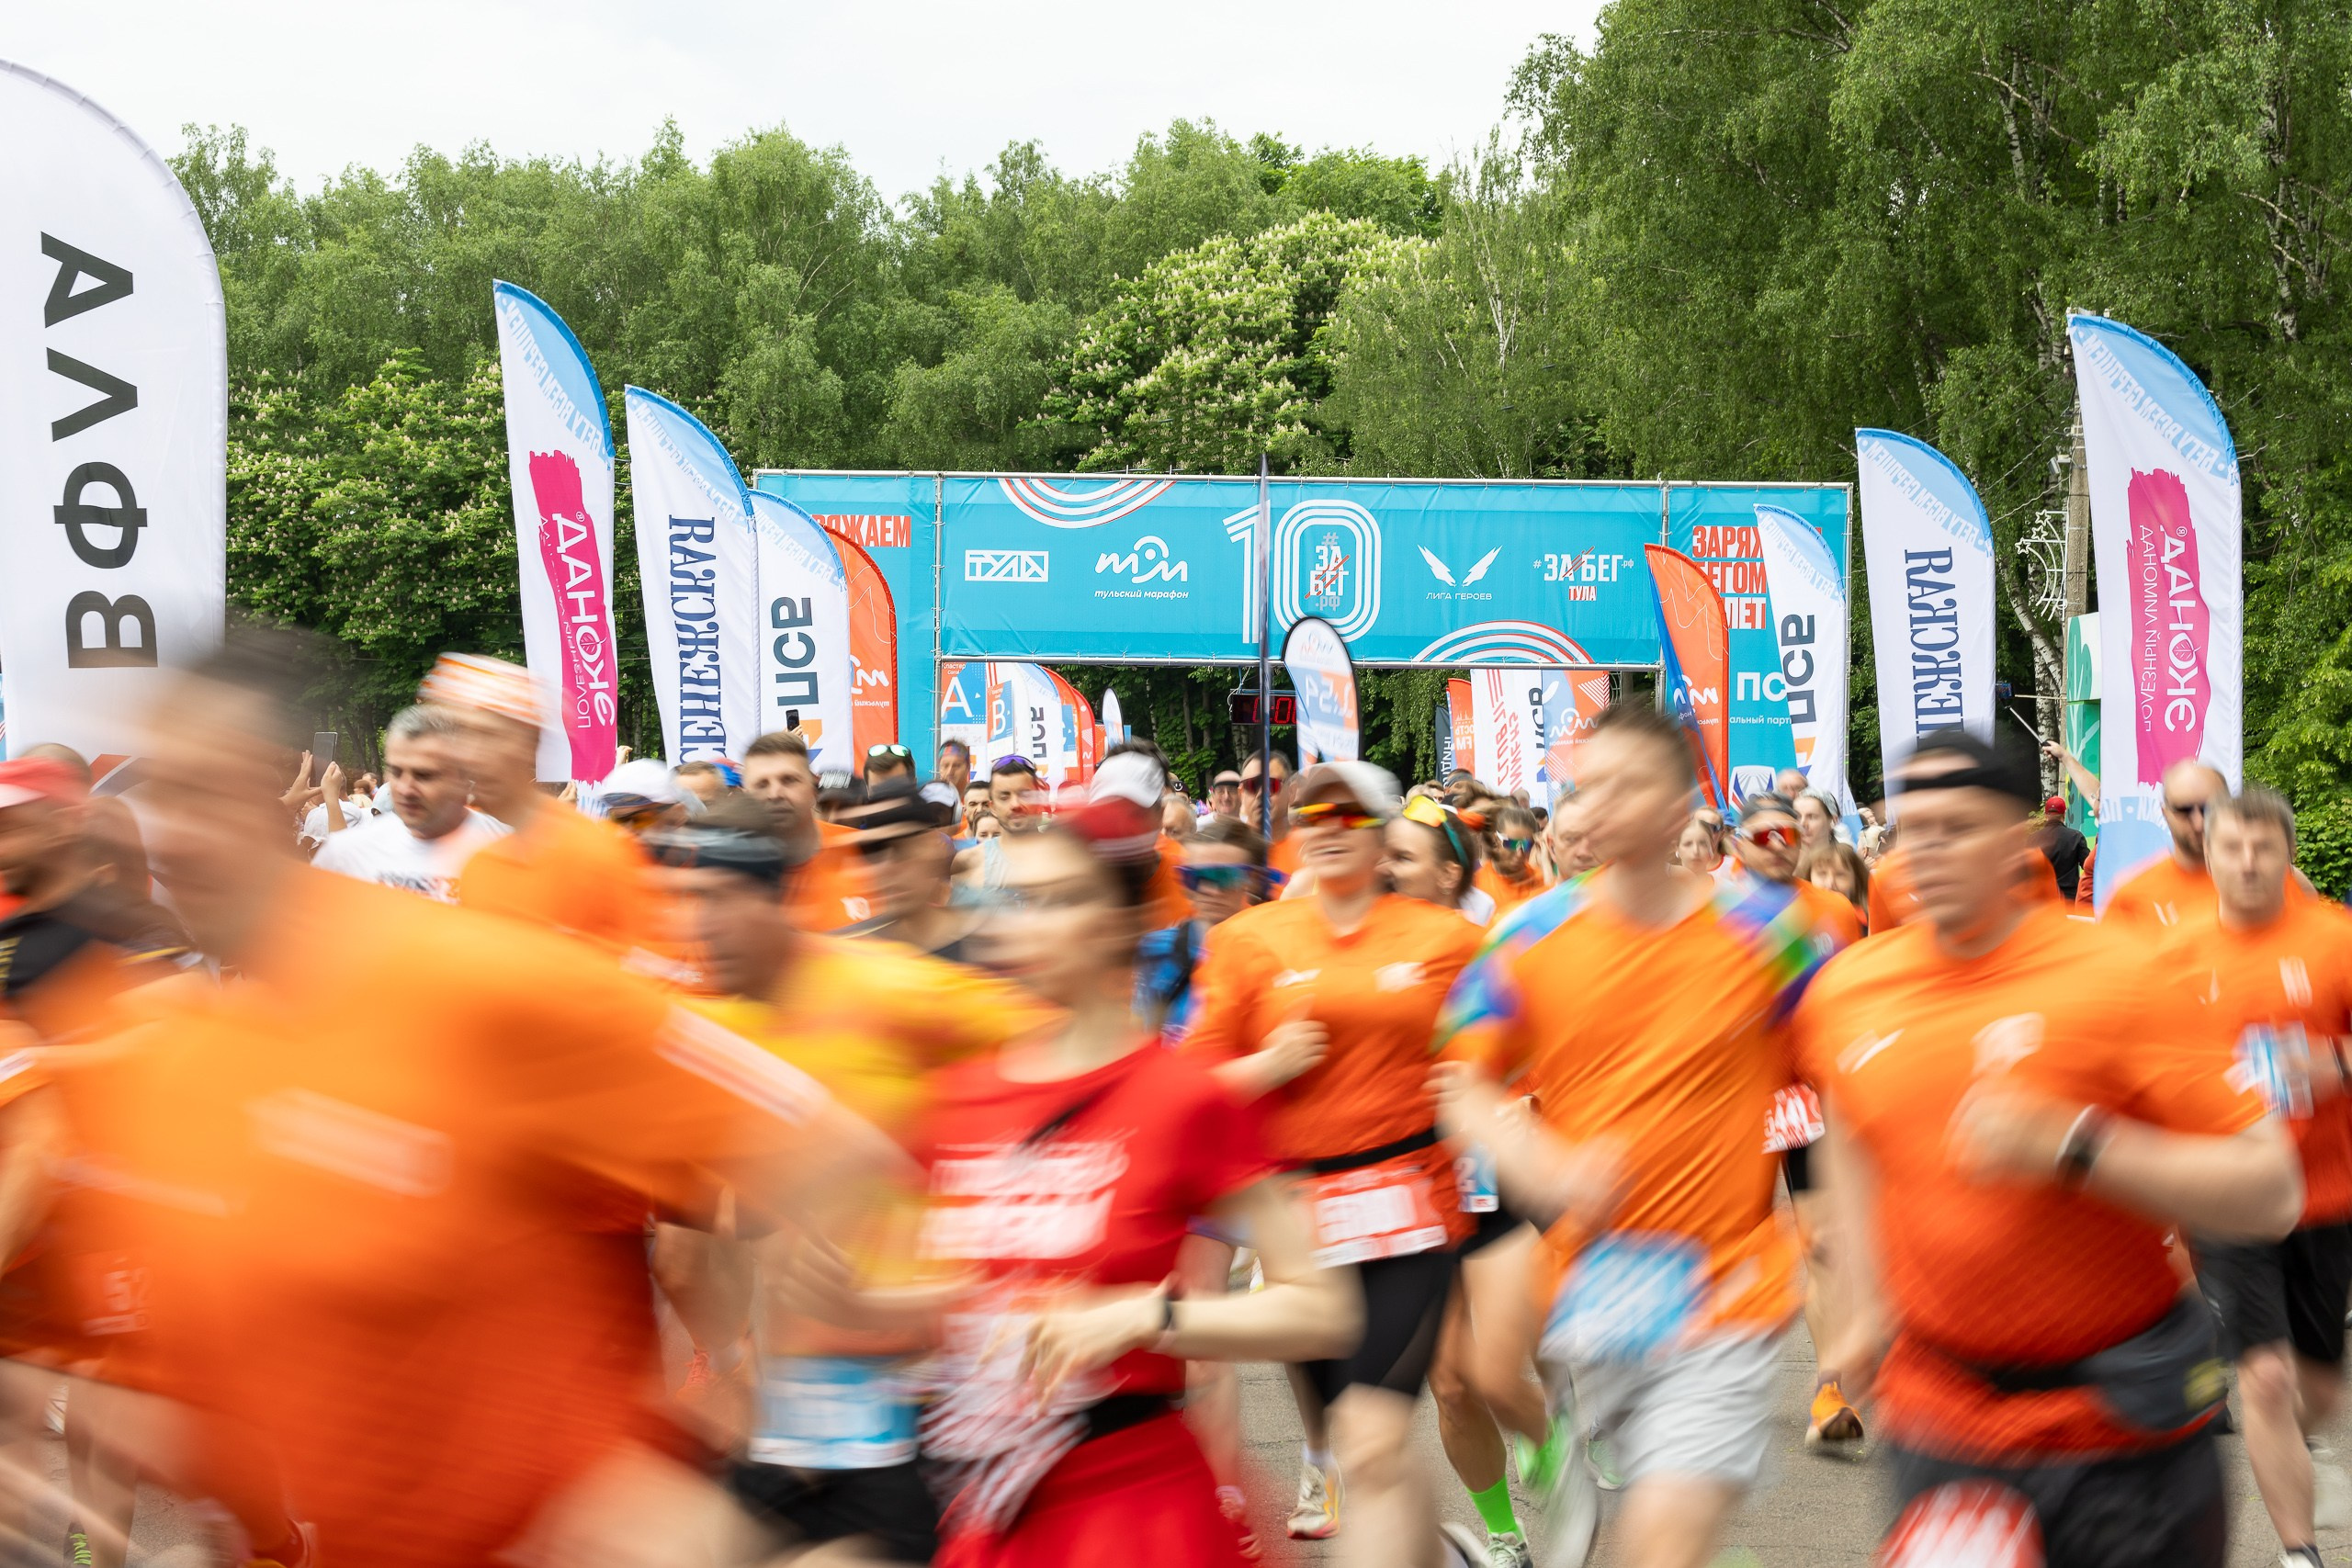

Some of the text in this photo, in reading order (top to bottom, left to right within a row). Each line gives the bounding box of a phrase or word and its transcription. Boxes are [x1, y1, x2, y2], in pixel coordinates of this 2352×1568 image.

[1223, 499, 1381, 644] 10
[1698, 561, 1768, 594] ЕГОМ
[1094, 589, 1190, 601] тульский марафон
[1454, 592, 1493, 601] ГЕРОЕВ
[1568, 585, 1598, 601] ТУЛА
[1736, 671, 1788, 702] ПС
